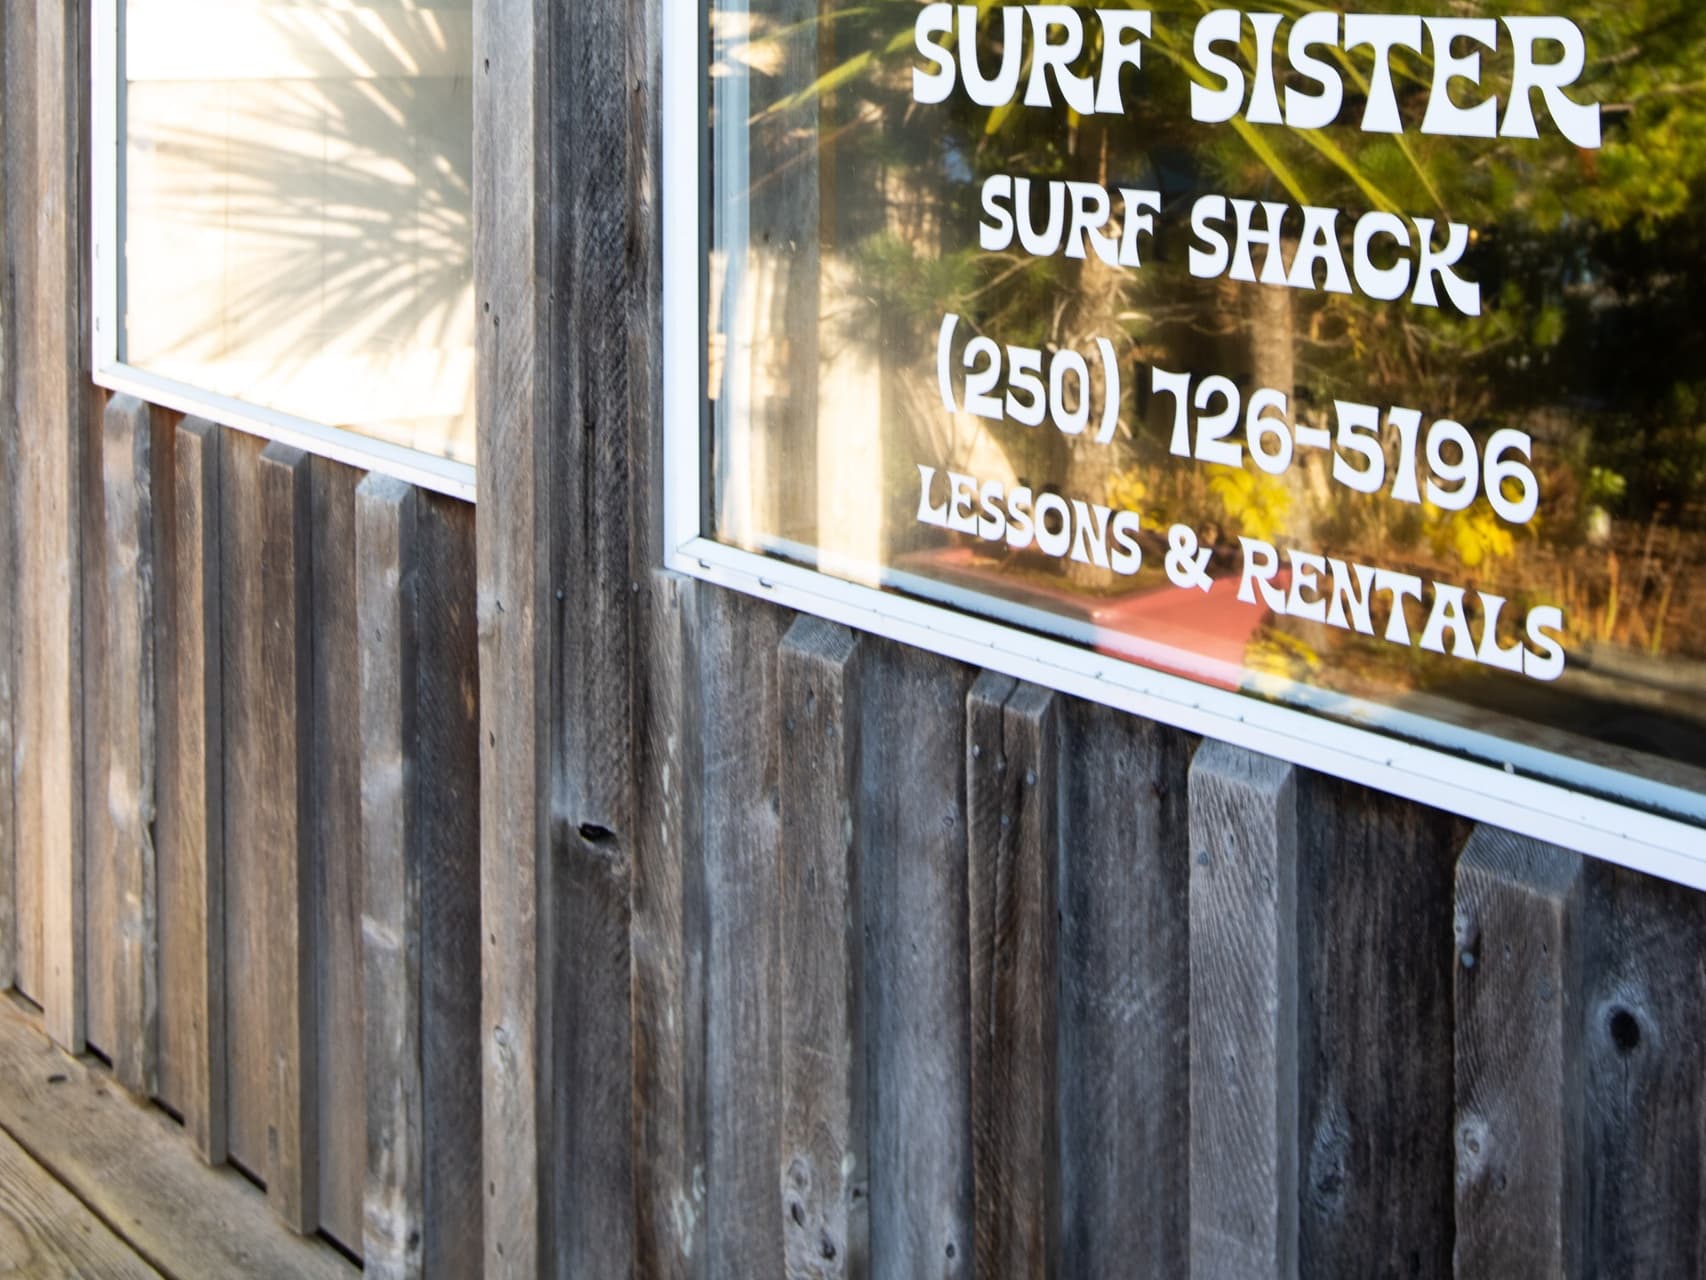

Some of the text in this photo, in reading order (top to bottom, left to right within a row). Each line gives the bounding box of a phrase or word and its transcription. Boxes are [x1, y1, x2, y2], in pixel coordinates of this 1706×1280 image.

[912, 2, 1601, 150] SURF SISTER
[979, 174, 1482, 317] SURF SHACK
[936, 313, 1541, 525] (250) 726-5196
[916, 464, 1566, 682] LESSONS & RENTALS
